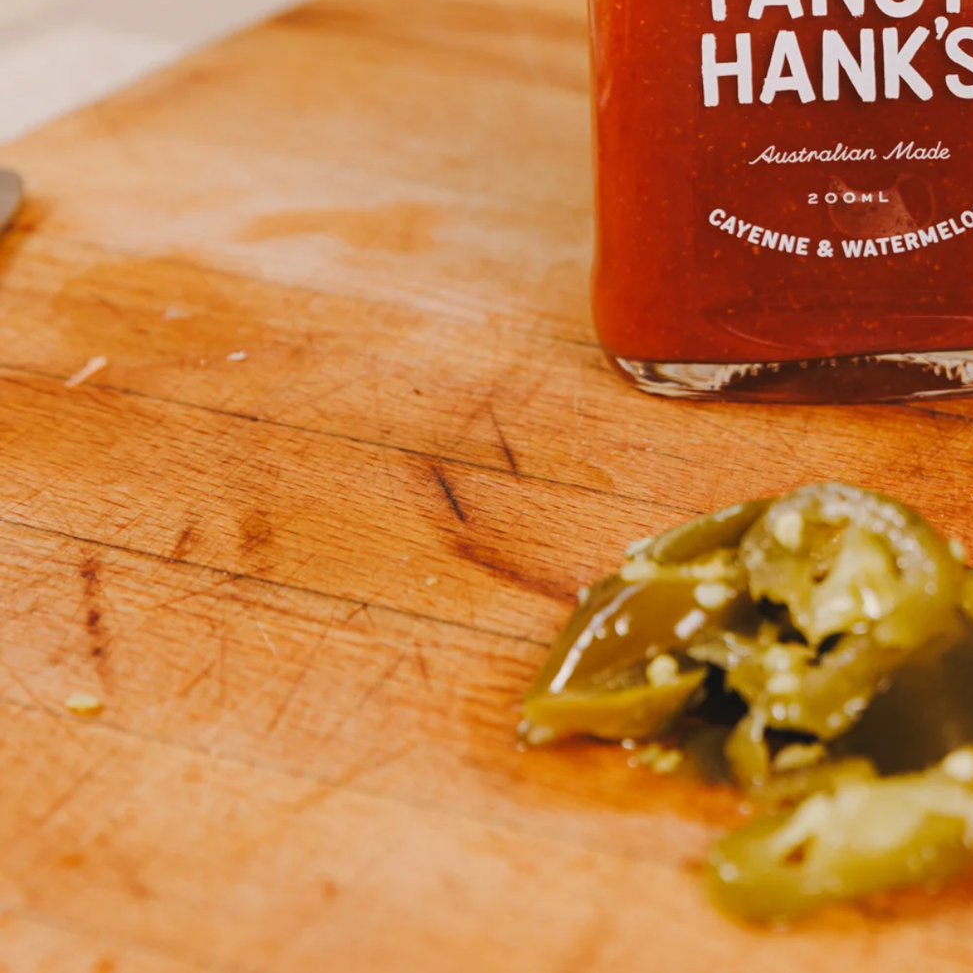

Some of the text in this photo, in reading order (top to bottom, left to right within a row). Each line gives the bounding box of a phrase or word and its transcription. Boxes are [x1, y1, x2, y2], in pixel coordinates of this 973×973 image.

[749, 141, 951, 165] Australian Made
[709, 208, 810, 255] CAYENNE
[817, 240, 834, 257] &
